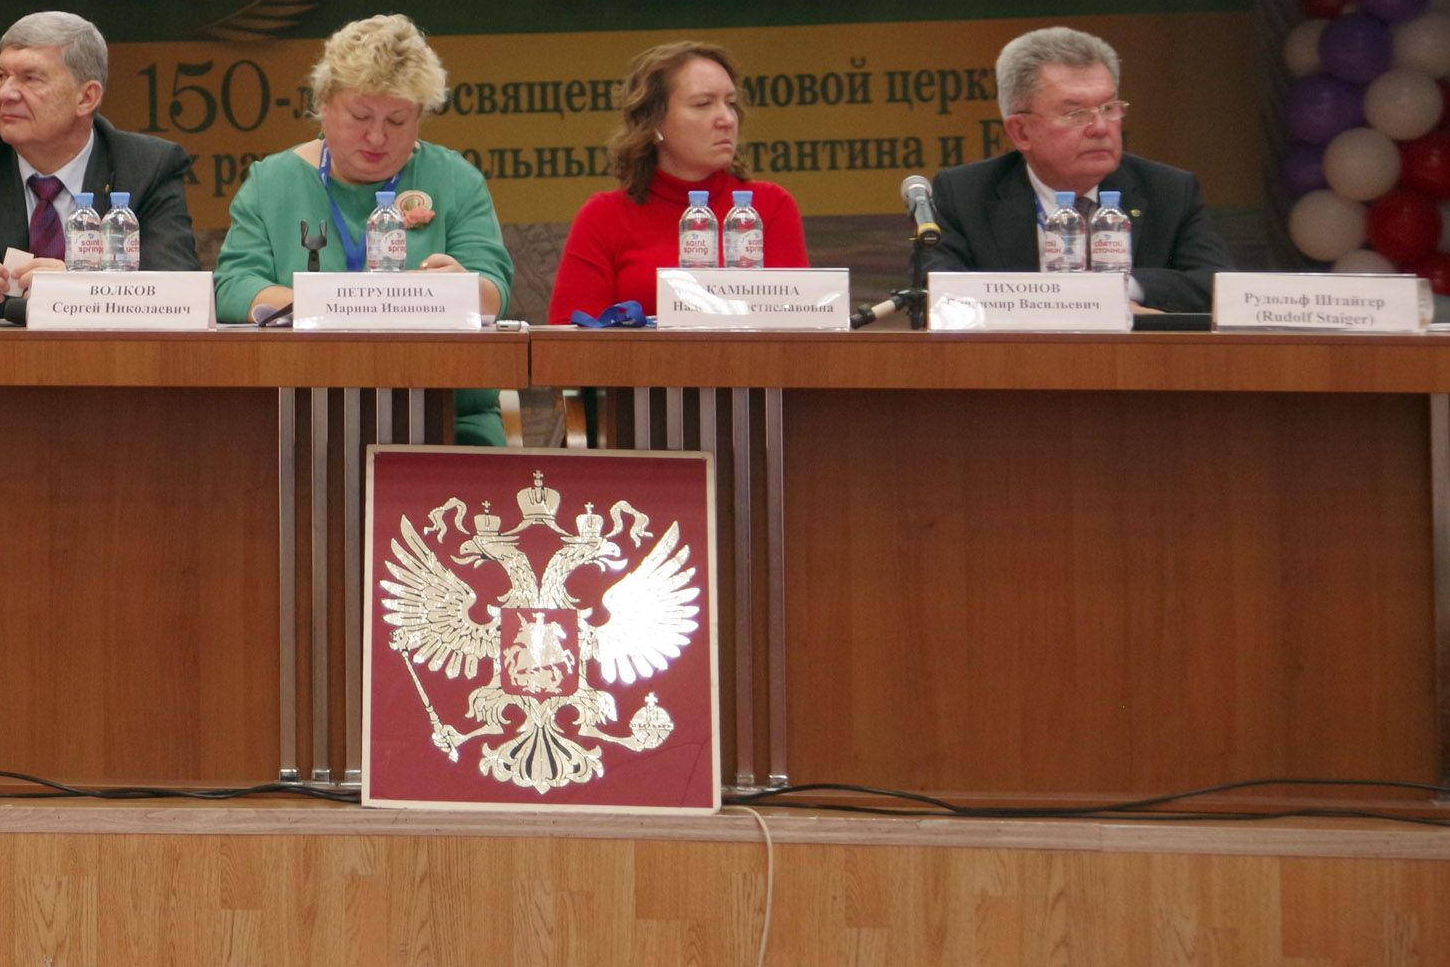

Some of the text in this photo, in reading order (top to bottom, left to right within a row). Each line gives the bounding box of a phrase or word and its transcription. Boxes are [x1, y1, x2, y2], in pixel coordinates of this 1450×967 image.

[138, 57, 999, 134] 150-л священ мовой церк
[744, 135, 924, 174] тантина
[685, 239, 706, 247] saint
[683, 246, 709, 255] spring
[90, 284, 156, 297] ВОЛКОВ
[336, 286, 434, 298] ПЕТРУШИНА
[706, 284, 800, 296] КАМЫНИНА
[983, 283, 1061, 294] ТИХОНОВ
[750, 301, 834, 313] стиславовна
[1020, 298, 1100, 310] Васильевич
[1244, 292, 1386, 310] Рудольф Штайгер
[52, 301, 191, 316] Сергей Николаевич
[326, 303, 446, 315] Марина Ивановна
[1256, 310, 1374, 326] (Rudolf Staiger)
